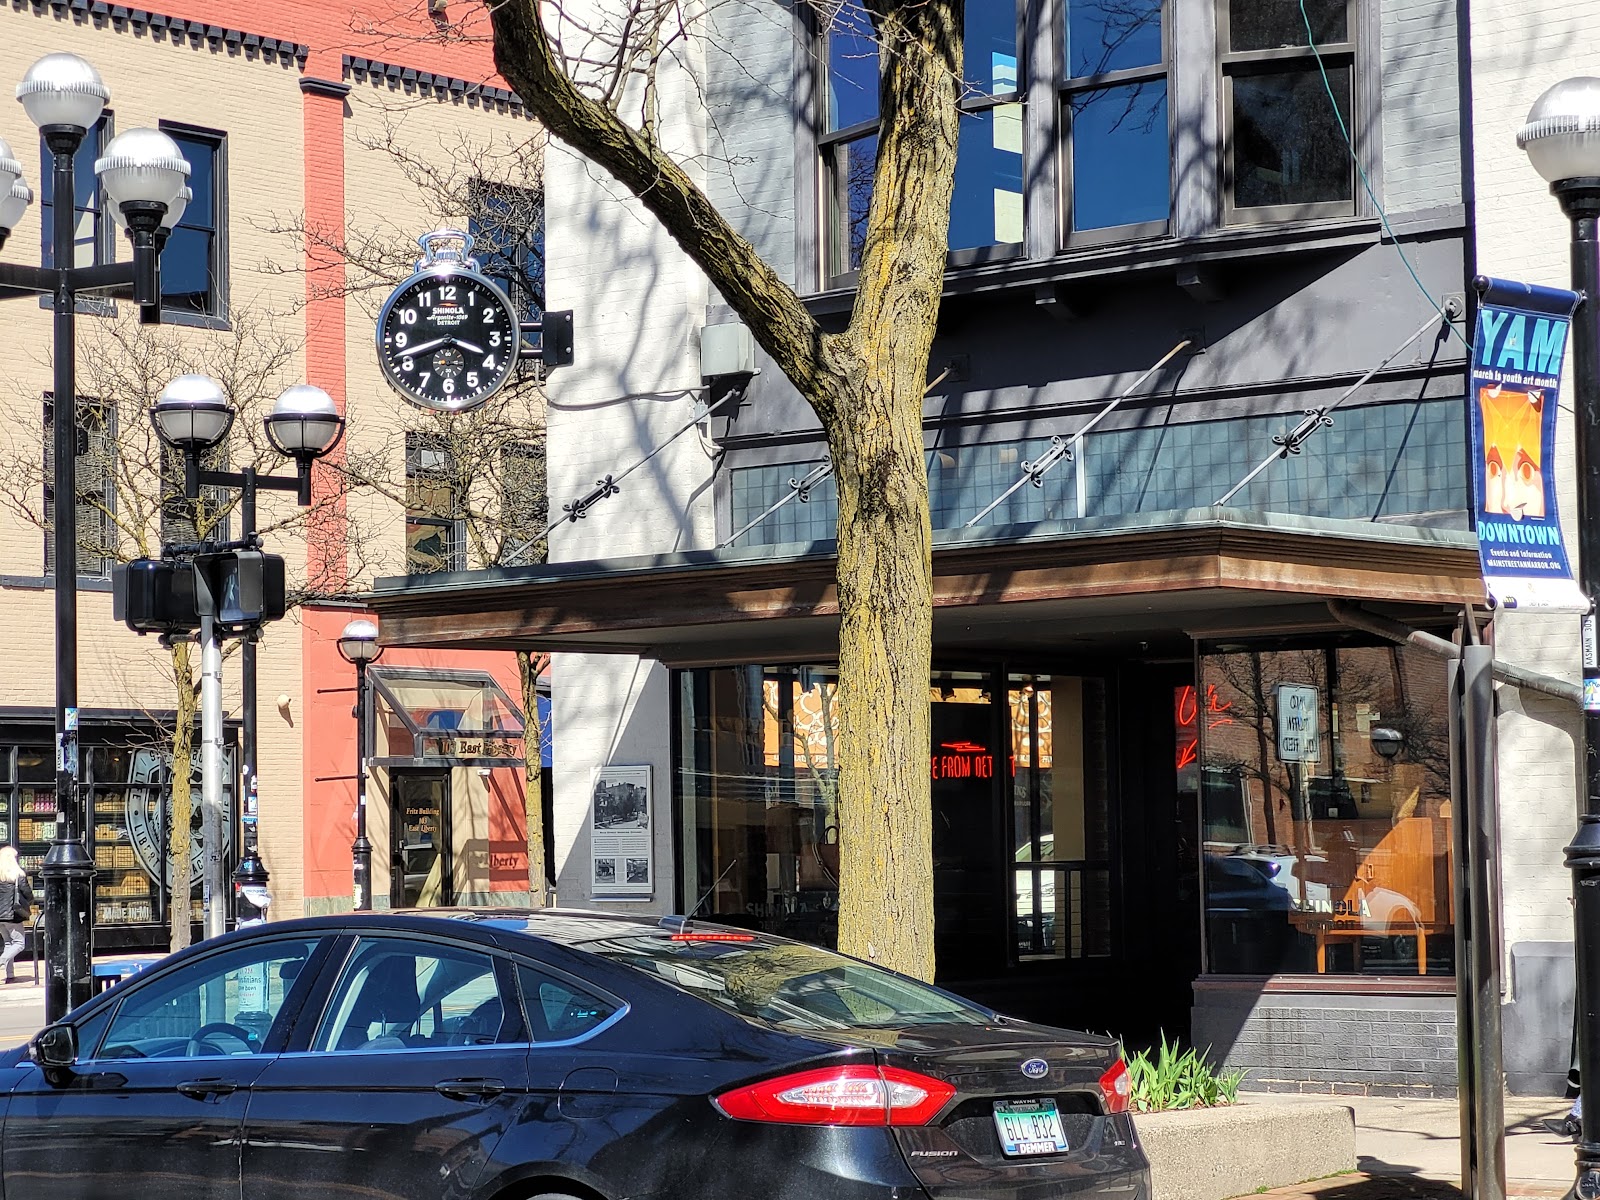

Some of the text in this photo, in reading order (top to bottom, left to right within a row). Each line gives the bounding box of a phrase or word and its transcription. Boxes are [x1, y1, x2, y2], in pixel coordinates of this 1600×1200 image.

[418, 292, 431, 307] 11
[439, 286, 456, 300] 12
[467, 291, 475, 306] 1
[399, 309, 417, 325] 10
[432, 307, 465, 315] SHINOLA
[482, 308, 494, 323] 2
[395, 332, 407, 348] 9
[489, 331, 501, 347] 3
[1481, 310, 1567, 375] YAM
[402, 356, 414, 371] 8
[482, 354, 495, 370] 4
[419, 372, 431, 388] 7
[442, 379, 454, 394] 6
[466, 372, 478, 387] 5
[1473, 370, 1493, 379] march
[1502, 373, 1522, 384] youth
[1523, 375, 1534, 385] art
[1534, 378, 1557, 388] month
[1478, 521, 1560, 546] DOWNTOWN
[1490, 549, 1552, 559] Events and Information
[459, 741, 481, 754] East
[941, 756, 971, 778] FROM
[975, 756, 1016, 778] DETT
[419, 808, 440, 816] Building
[134, 823, 161, 874] LIBERT
[1019, 1141, 1055, 1154] DEMMER
